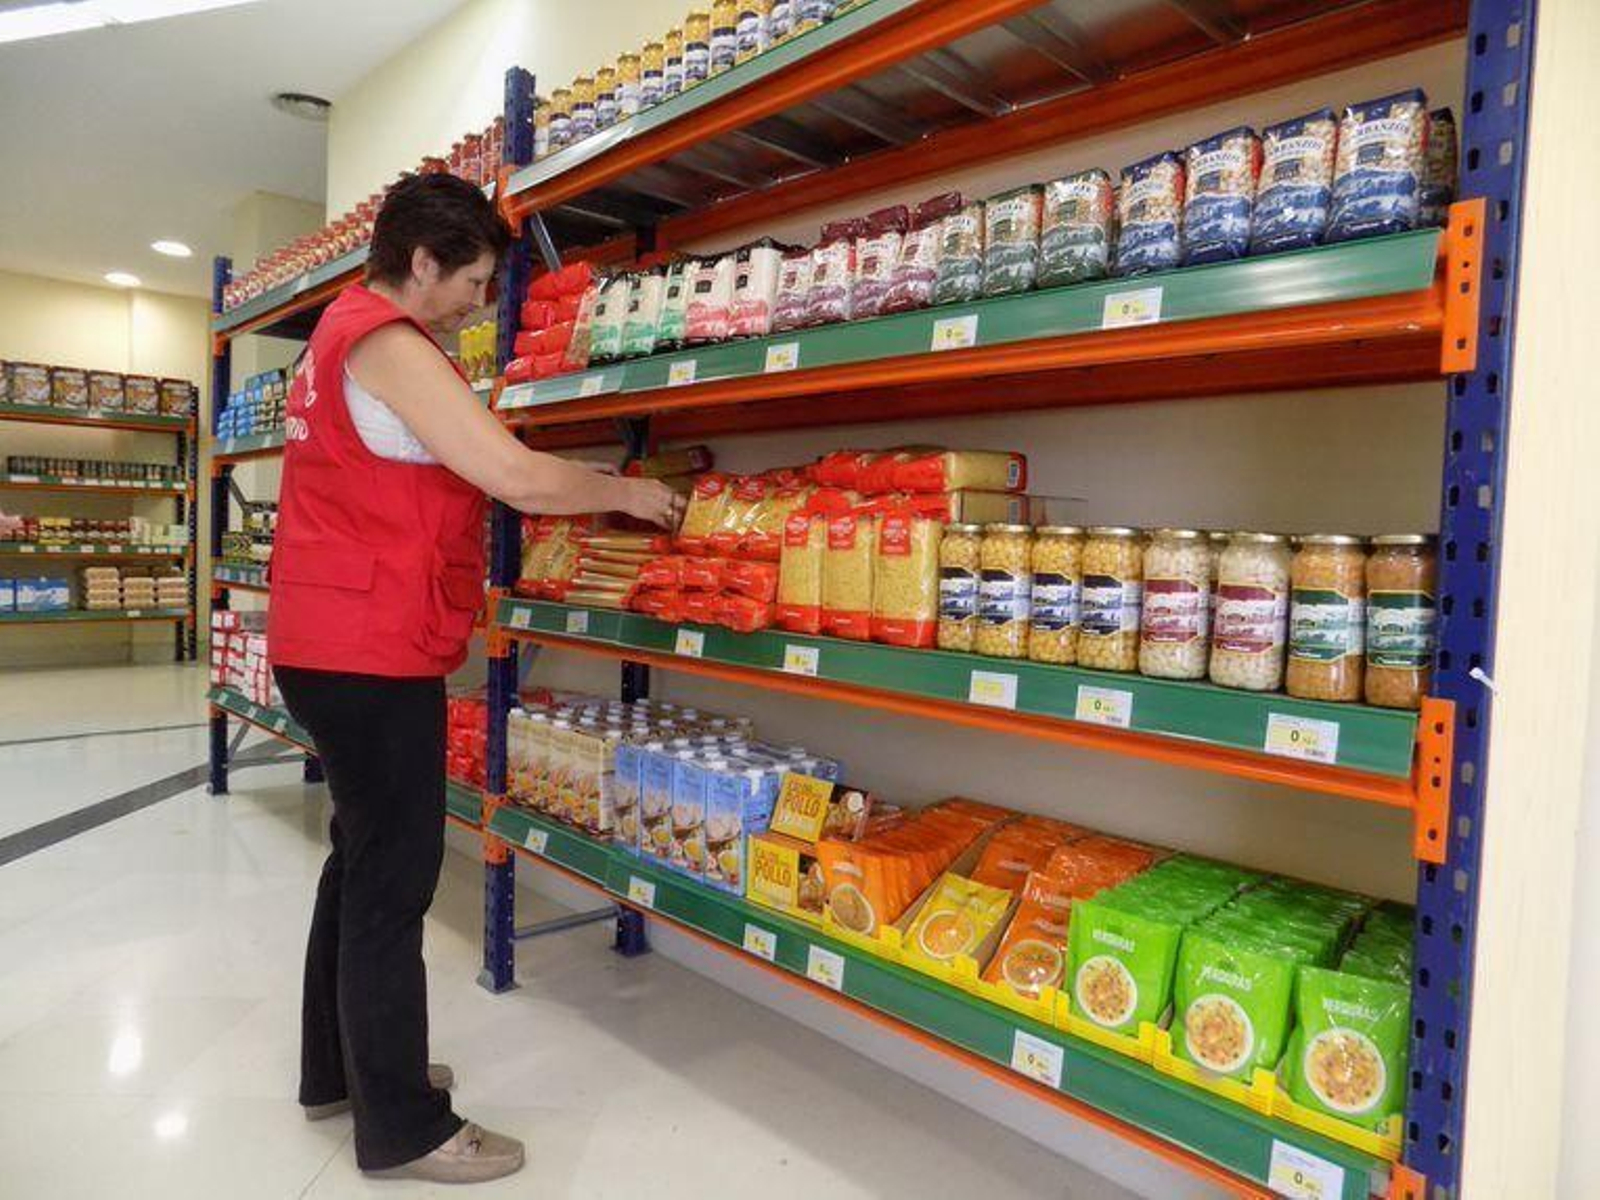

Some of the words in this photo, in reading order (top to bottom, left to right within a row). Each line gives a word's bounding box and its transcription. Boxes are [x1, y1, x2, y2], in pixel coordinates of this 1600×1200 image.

[1094, 700, 1102, 711] 0
[1290, 730, 1300, 742] 0
[755, 859, 791, 888] POLLO
[1294, 1171, 1303, 1185] 0
